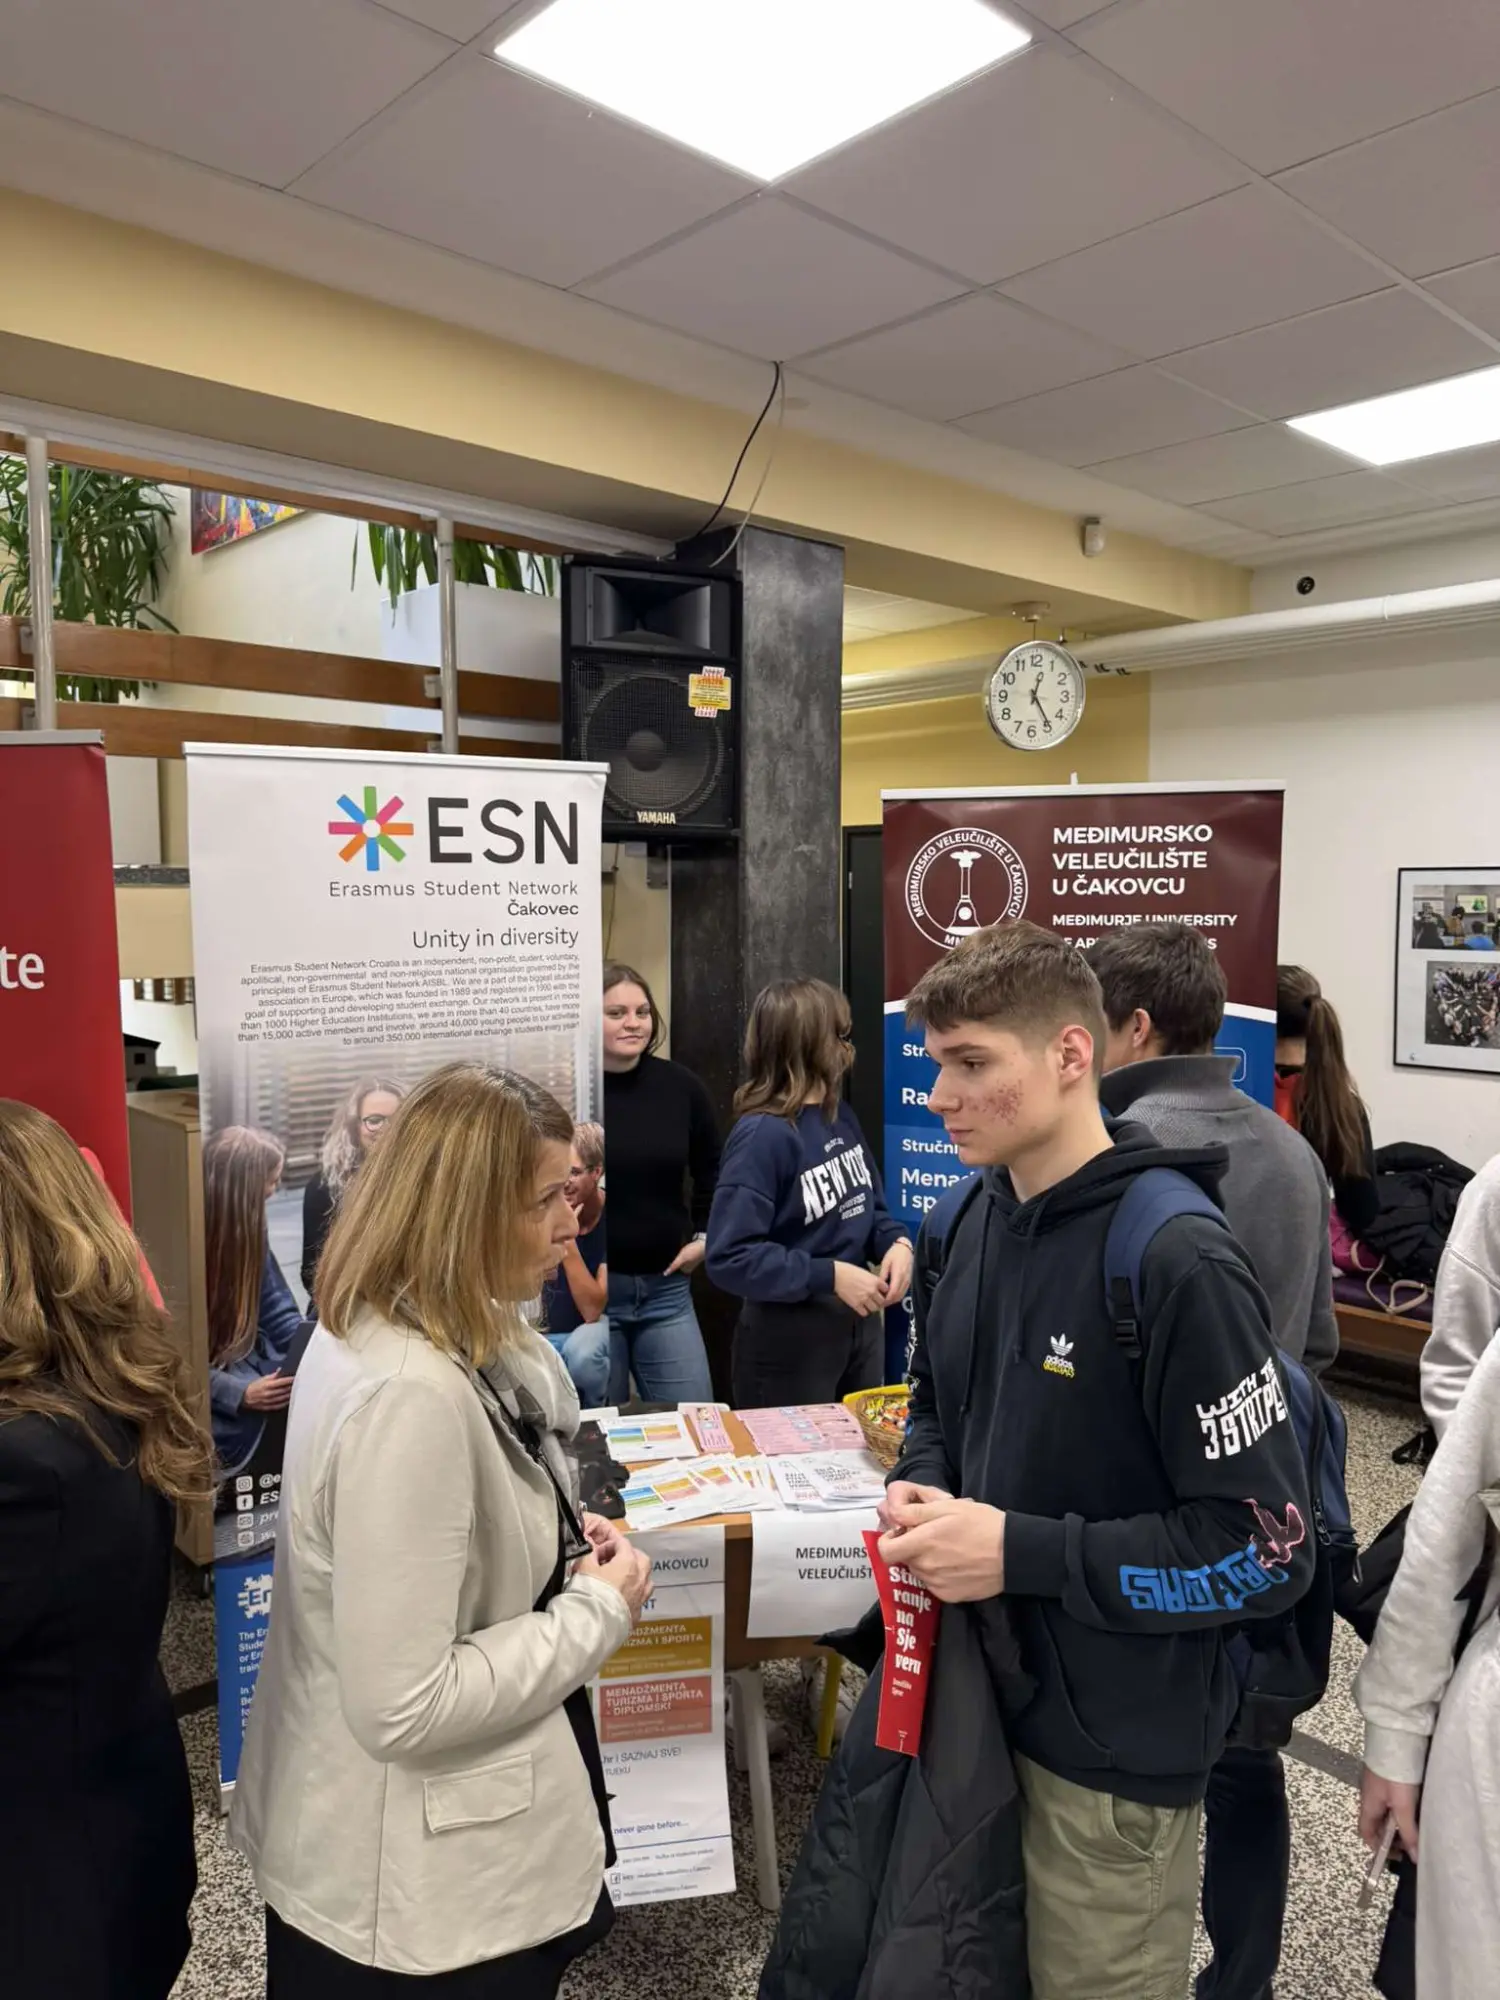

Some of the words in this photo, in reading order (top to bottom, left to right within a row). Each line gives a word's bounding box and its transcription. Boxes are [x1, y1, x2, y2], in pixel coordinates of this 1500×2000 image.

[1016, 660, 1025, 672] 11
[1030, 654, 1043, 667] 12
[1050, 660, 1054, 672] 1
[1002, 672, 1015, 685] 10
[1057, 672, 1067, 685] 2
[998, 690, 1008, 702] 9
[1060, 690, 1070, 703] 3
[1001, 708, 1011, 720] 8
[1055, 709, 1064, 720] 4
[1014, 721, 1023, 733] 7
[1027, 725, 1036, 738] 6
[636, 811, 676, 824] YAMAHA
[428, 797, 578, 864] ESN
[1053, 824, 1213, 844] MEĐIMURSKO
[936, 831, 1007, 857] VELEUČILIŠTE
[1004, 854, 1014, 864] U
[1052, 847, 1207, 870] VELEUČILIŠTE
[330, 881, 415, 897] Erasmus
[424, 880, 500, 895] Student
[508, 880, 578, 895] Network
[1008, 864, 1023, 918] ČAKOVCU
[1052, 878, 1068, 895] U
[1072, 874, 1185, 895] ČAKOVCU
[507, 900, 579, 916] Čakovec
[1052, 915, 1142, 926] MEĐIMURJE
[413, 928, 470, 951] Unity
[476, 928, 494, 946] in
[500, 927, 578, 948] diversity
[0, 946, 44, 989] te
[251, 964, 292, 973] Erasmus
[295, 963, 328, 971] Student
[332, 961, 366, 970] Network
[369, 960, 400, 968] Croatia
[424, 956, 476, 966] independent,
[479, 955, 517, 964] non-profit,
[241, 975, 284, 985] apolitical,
[288, 971, 366, 983] non-governmental
[390, 969, 442, 977] non-religious
[479, 966, 524, 975] organisation
[527, 964, 556, 973] governed
[558, 963, 565, 971] by
[252, 987, 295, 996] principles
[298, 985, 306, 993] of
[309, 984, 347, 992] Erasmus
[350, 982, 383, 990] Student
[491, 977, 506, 985] part
[530, 974, 552, 983] biggest
[259, 997, 309, 1006] association
[322, 994, 356, 1002] Europe,
[359, 992, 383, 1000] which
[406, 990, 438, 998] founded
[490, 987, 526, 995] registered
[245, 1010, 265, 1020] goal
[268, 1009, 276, 1017] of
[280, 1008, 325, 1018] supporting
[347, 1004, 394, 1012] developing
[396, 1001, 426, 1009] student
[429, 1000, 469, 1008] exchange.
[473, 997, 488, 1005] Our
[530, 995, 552, 1003] present
[238, 1033, 259, 1041] than
[263, 1030, 293, 1040] 15,000
[324, 1027, 364, 1035] members
[420, 1021, 448, 1029] around
[450, 1019, 478, 1027] 40,000
[507, 1016, 530, 1024] people
[265, 1019, 287, 1028] 1000
[290, 1018, 319, 1028] Higher
[322, 1016, 364, 1024] Education
[368, 1013, 415, 1022] Institutions,
[354, 1035, 384, 1044] around
[387, 1033, 421, 1042] 350,000
[423, 1029, 471, 1039] international
[474, 1028, 512, 1036] exchange
[902, 1044, 930, 1057] Str
[902, 1087, 931, 1105] Ra
[902, 1138, 958, 1154] Stručni
[902, 1168, 975, 1188] Mena
[800, 1156, 847, 1226] NEW
[902, 1189, 906, 1207] i
[912, 1194, 937, 1214] sp
[1196, 1372, 1257, 1419] WITH
[1201, 1418, 1220, 1459] 3
[796, 1547, 868, 1559] MEĐIMURS
[653, 1558, 709, 1571] AKOVCU
[798, 1565, 872, 1579] VELEUČILIŠT
[893, 1588, 932, 1613] ranje
[896, 1609, 914, 1627] na
[239, 1632, 255, 1641] The
[660, 1634, 703, 1645] SPORTA
[896, 1627, 916, 1653] Sje
[895, 1653, 921, 1675] veru
[606, 1694, 654, 1708] TURIZMA
[661, 1690, 704, 1702] SPORTA
[621, 1749, 658, 1762] SAZNAJ
[614, 1826, 634, 1834] never
[637, 1824, 655, 1834] gone
